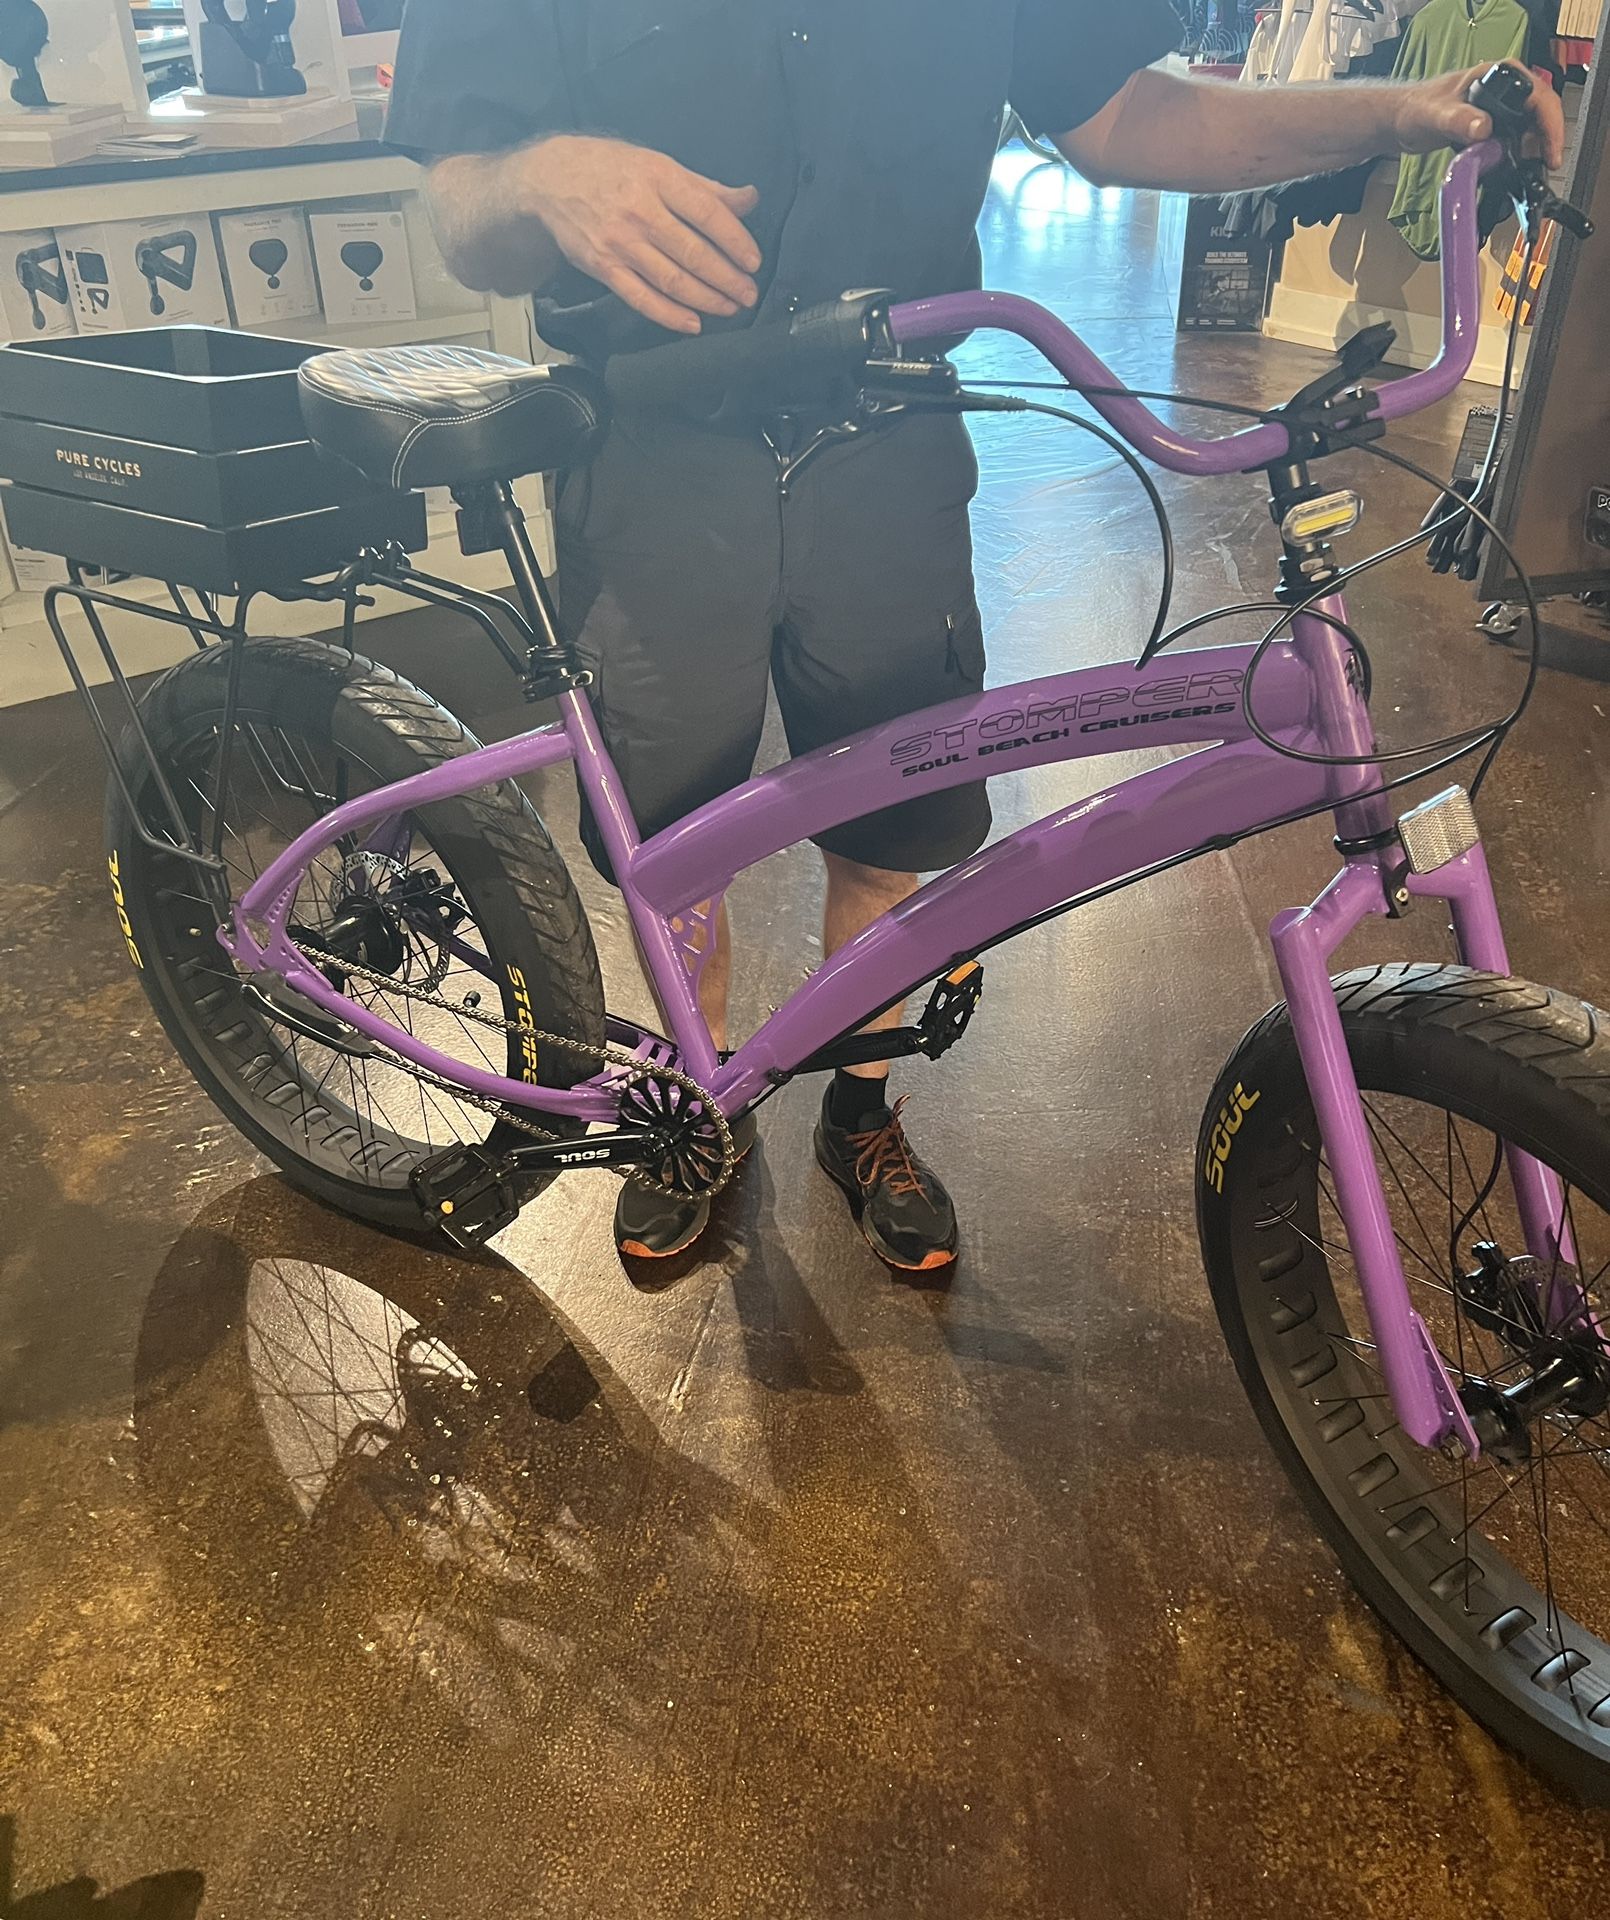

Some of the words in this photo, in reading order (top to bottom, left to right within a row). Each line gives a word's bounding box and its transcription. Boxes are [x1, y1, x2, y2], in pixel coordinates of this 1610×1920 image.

[56, 449, 90, 467] PURE
[94, 456, 141, 477] CYCLES
[890, 669, 1244, 766] STOMPER
[902, 753, 969, 778] SOUL
[978, 728, 1070, 756] BEACH
[1080, 702, 1236, 734] CRUISERS
[108, 849, 145, 970] SOUL
[506, 963, 538, 1086] STOMPE
[553, 1148, 611, 1163] SOUL
